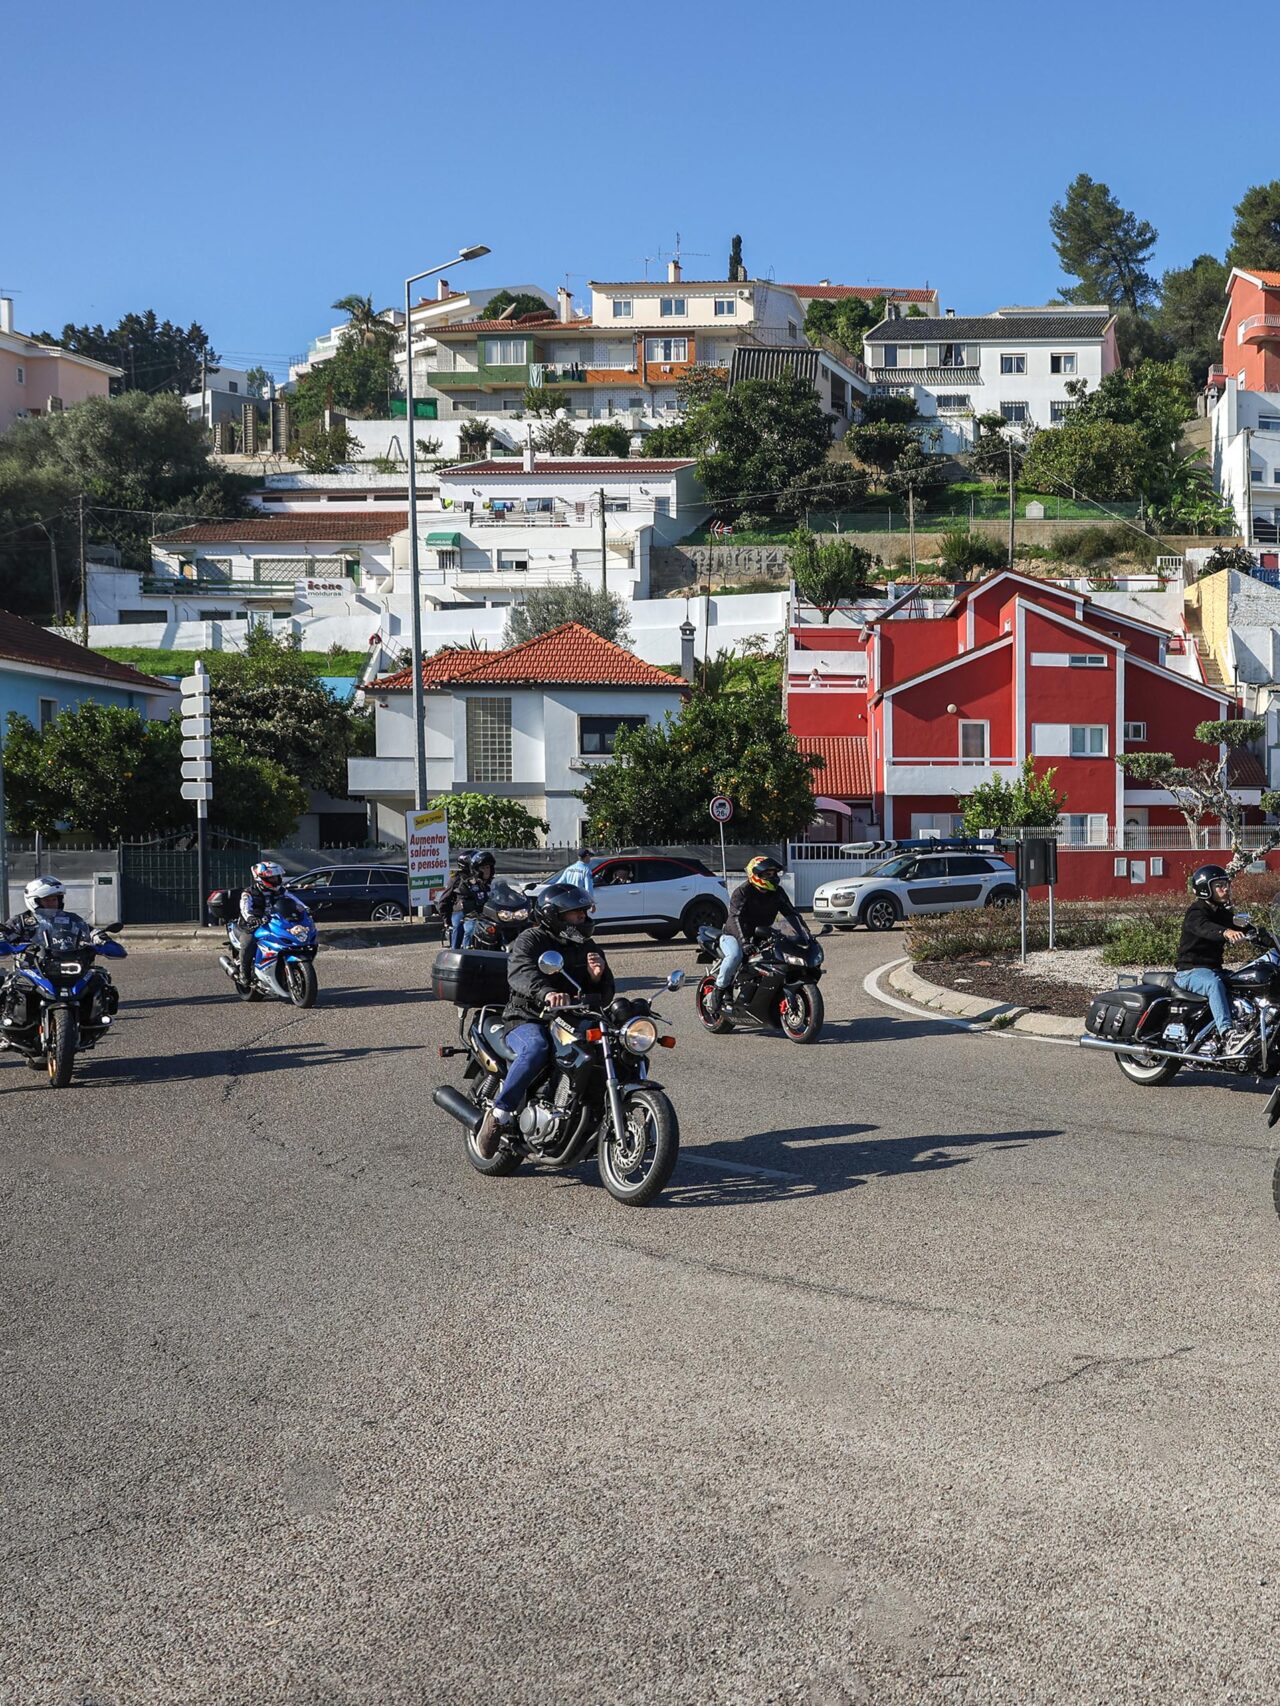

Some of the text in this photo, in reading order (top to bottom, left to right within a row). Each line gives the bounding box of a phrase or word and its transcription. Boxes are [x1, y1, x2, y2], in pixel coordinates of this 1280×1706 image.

[410, 833, 446, 845] Aumentar
[410, 845, 440, 858] salários
[411, 858, 447, 872] e pensões
[554, 1016, 576, 1034] HONDA
